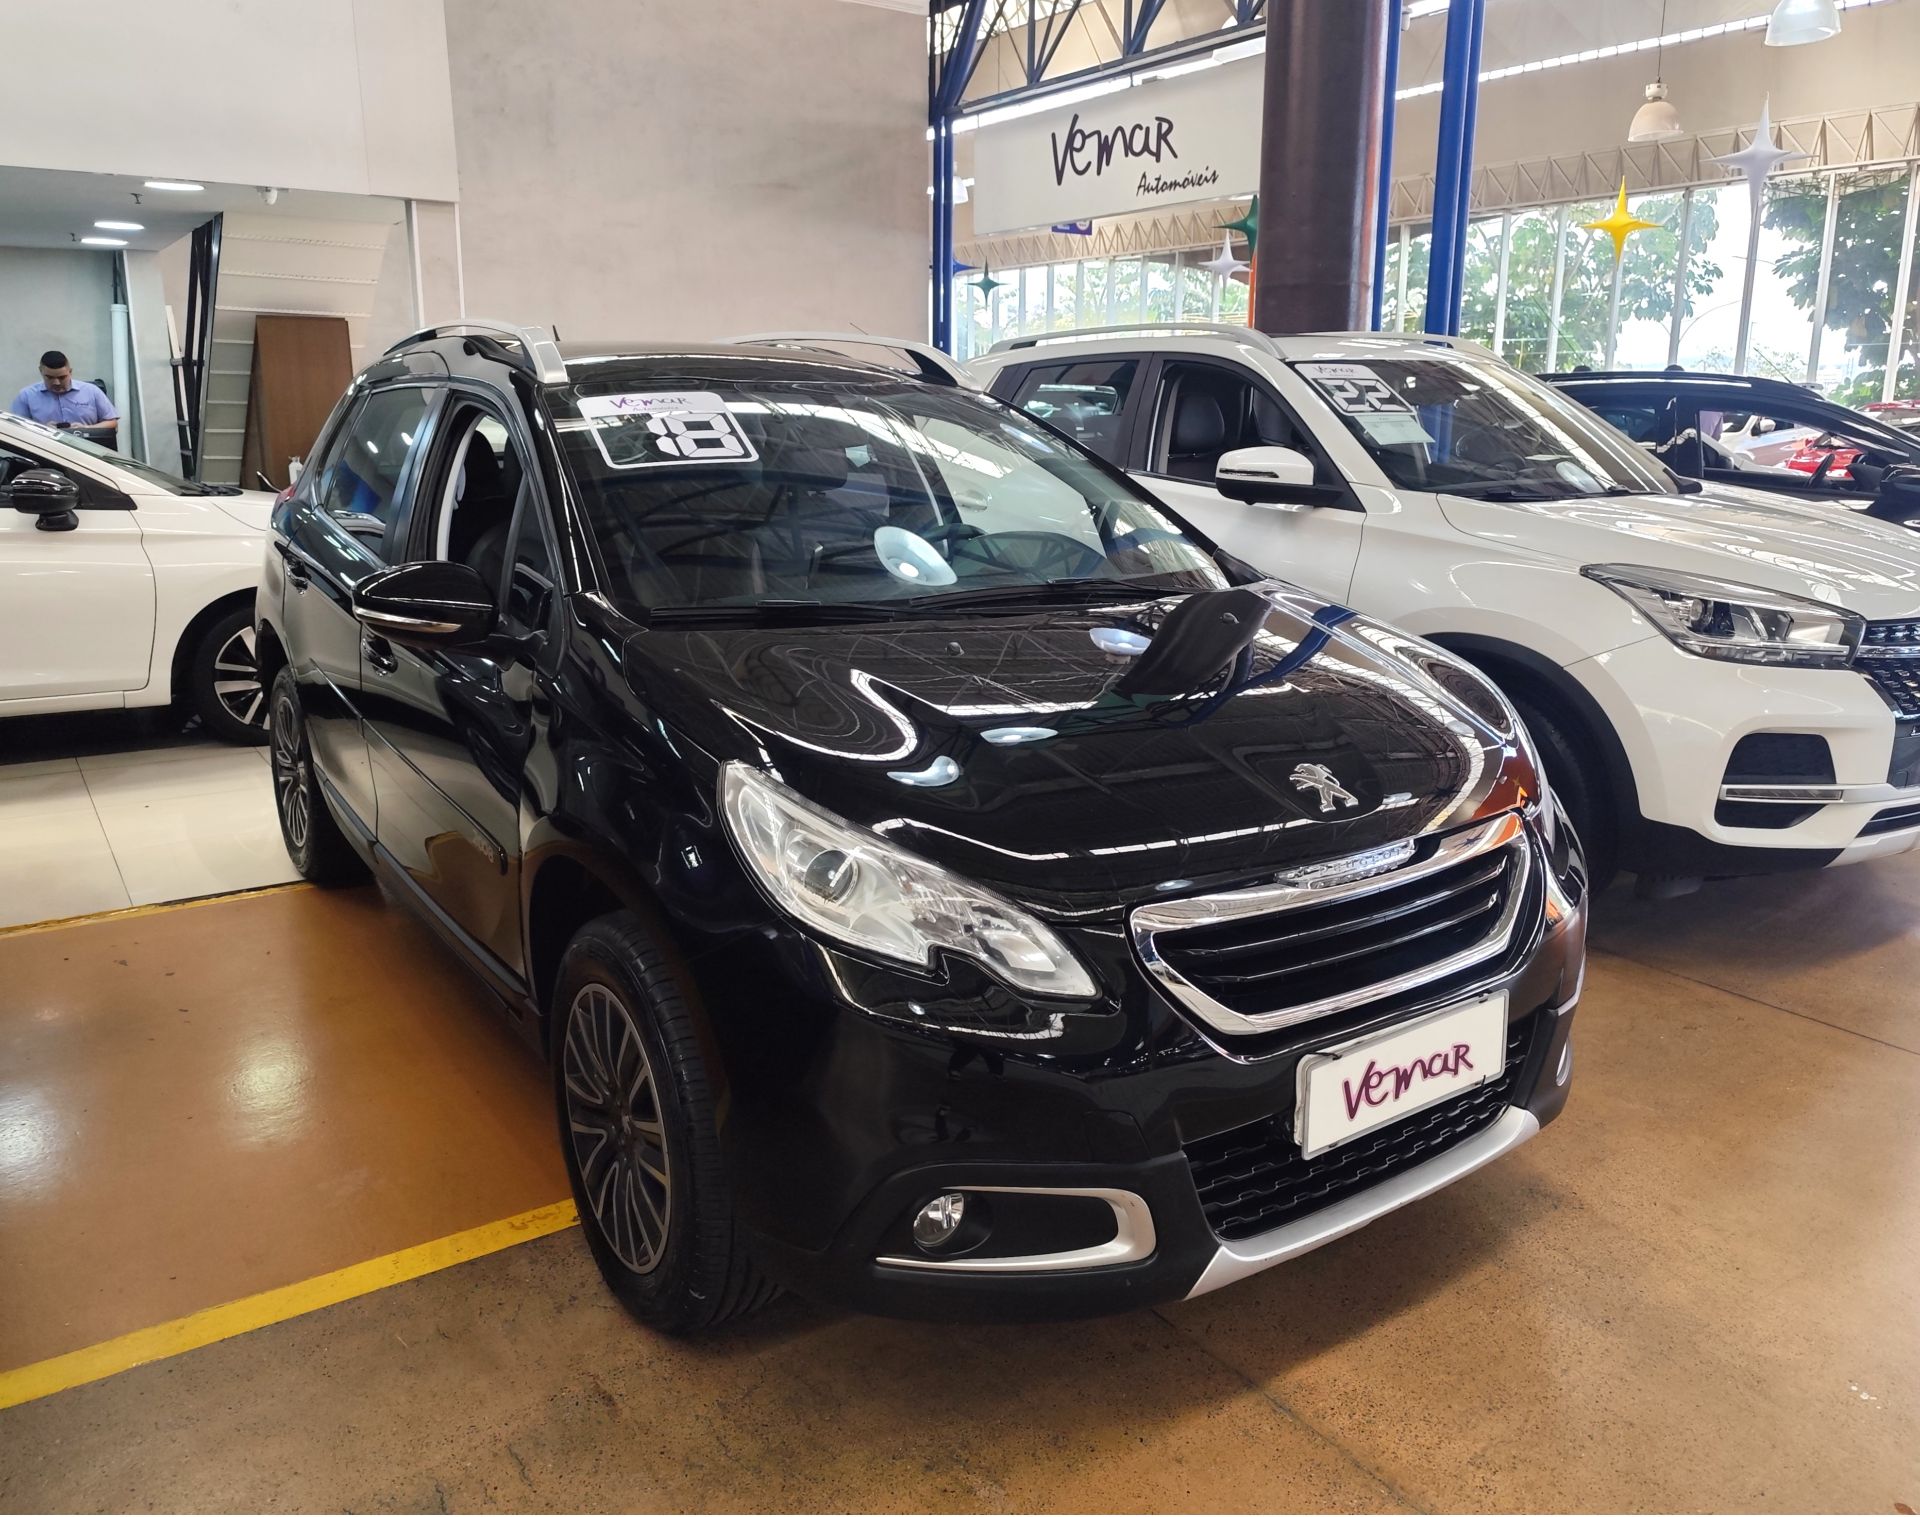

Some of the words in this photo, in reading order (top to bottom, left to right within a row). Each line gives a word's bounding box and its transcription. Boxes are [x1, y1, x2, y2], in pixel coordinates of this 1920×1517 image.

[1136, 166, 1219, 197] Automóveis
[1317, 379, 1409, 411] 22
[646, 412, 745, 457] 18
